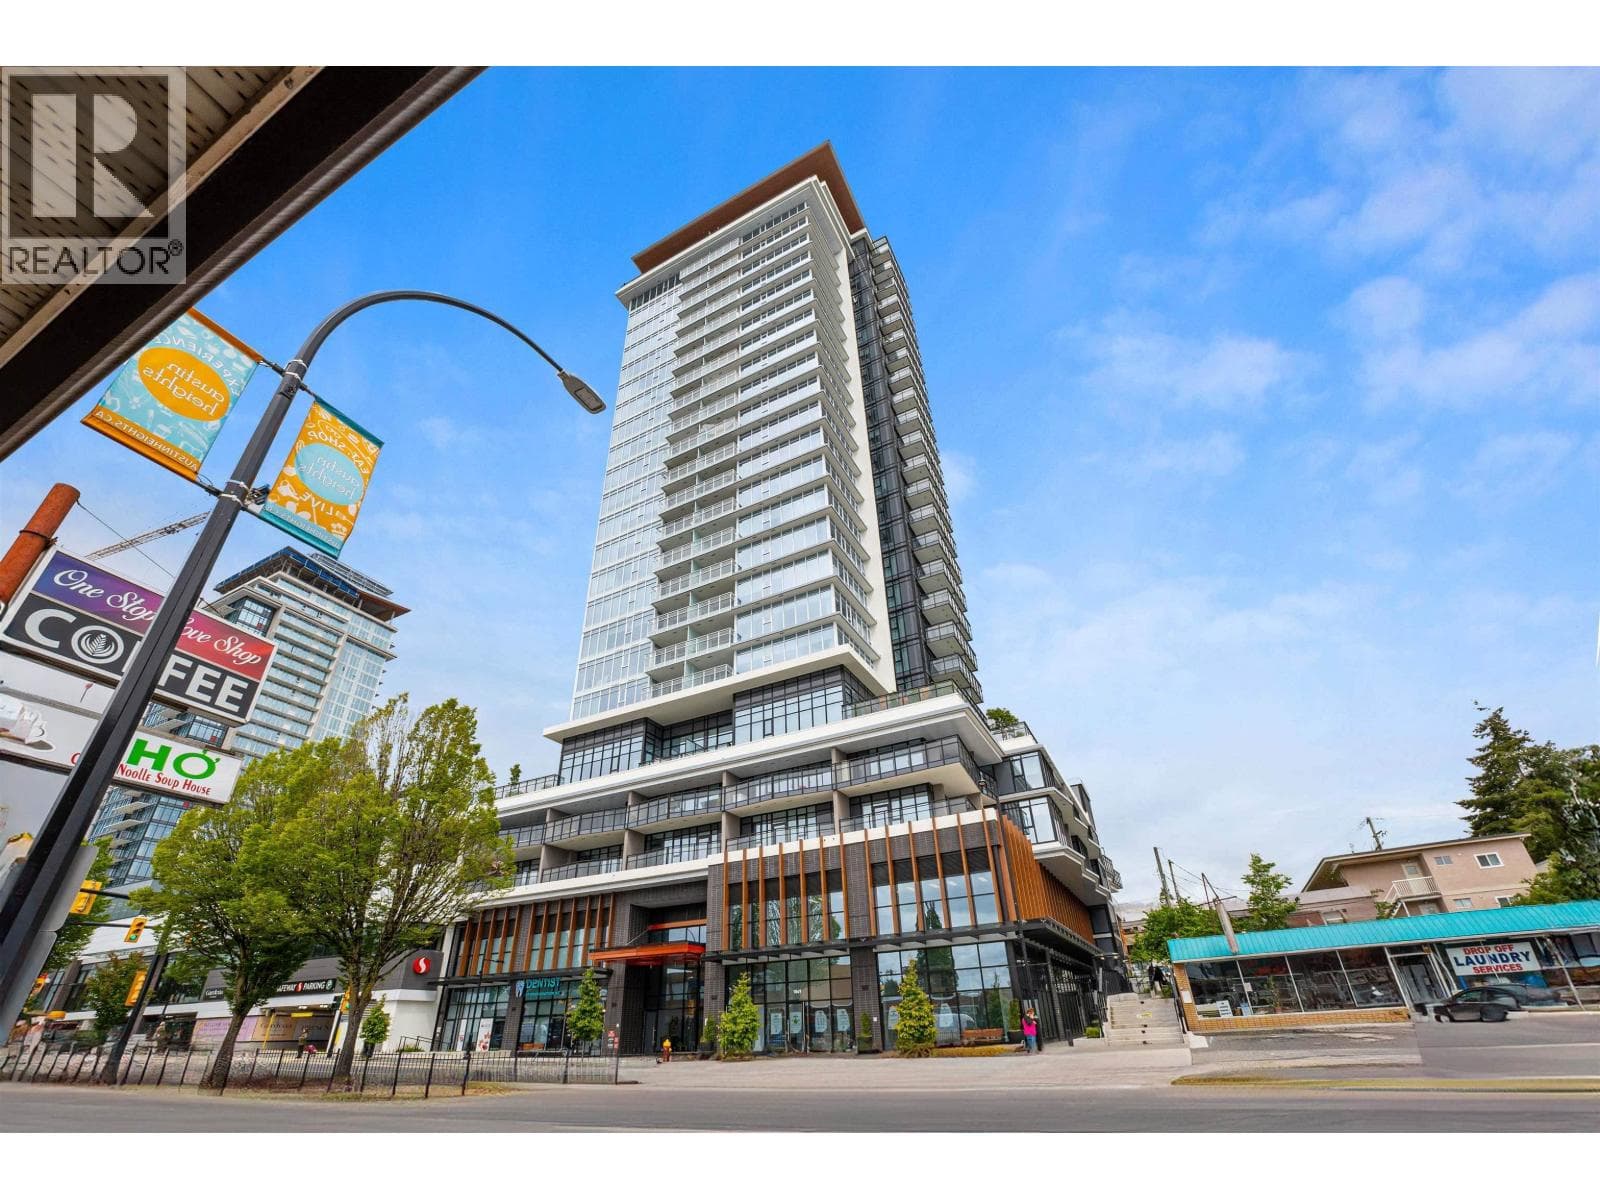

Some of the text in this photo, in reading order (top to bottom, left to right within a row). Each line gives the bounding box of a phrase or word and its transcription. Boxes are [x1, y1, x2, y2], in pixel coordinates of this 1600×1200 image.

[53, 569, 104, 598] One
[181, 618, 212, 643] ove
[213, 635, 262, 665] Shop
[154, 771, 180, 790] Soup
[182, 778, 212, 796] House
[1462, 943, 1515, 955] DROP OFF
[1453, 951, 1532, 967] LAUNDRY
[1472, 963, 1524, 974] SERVICES
[526, 977, 561, 989] DENTIST
